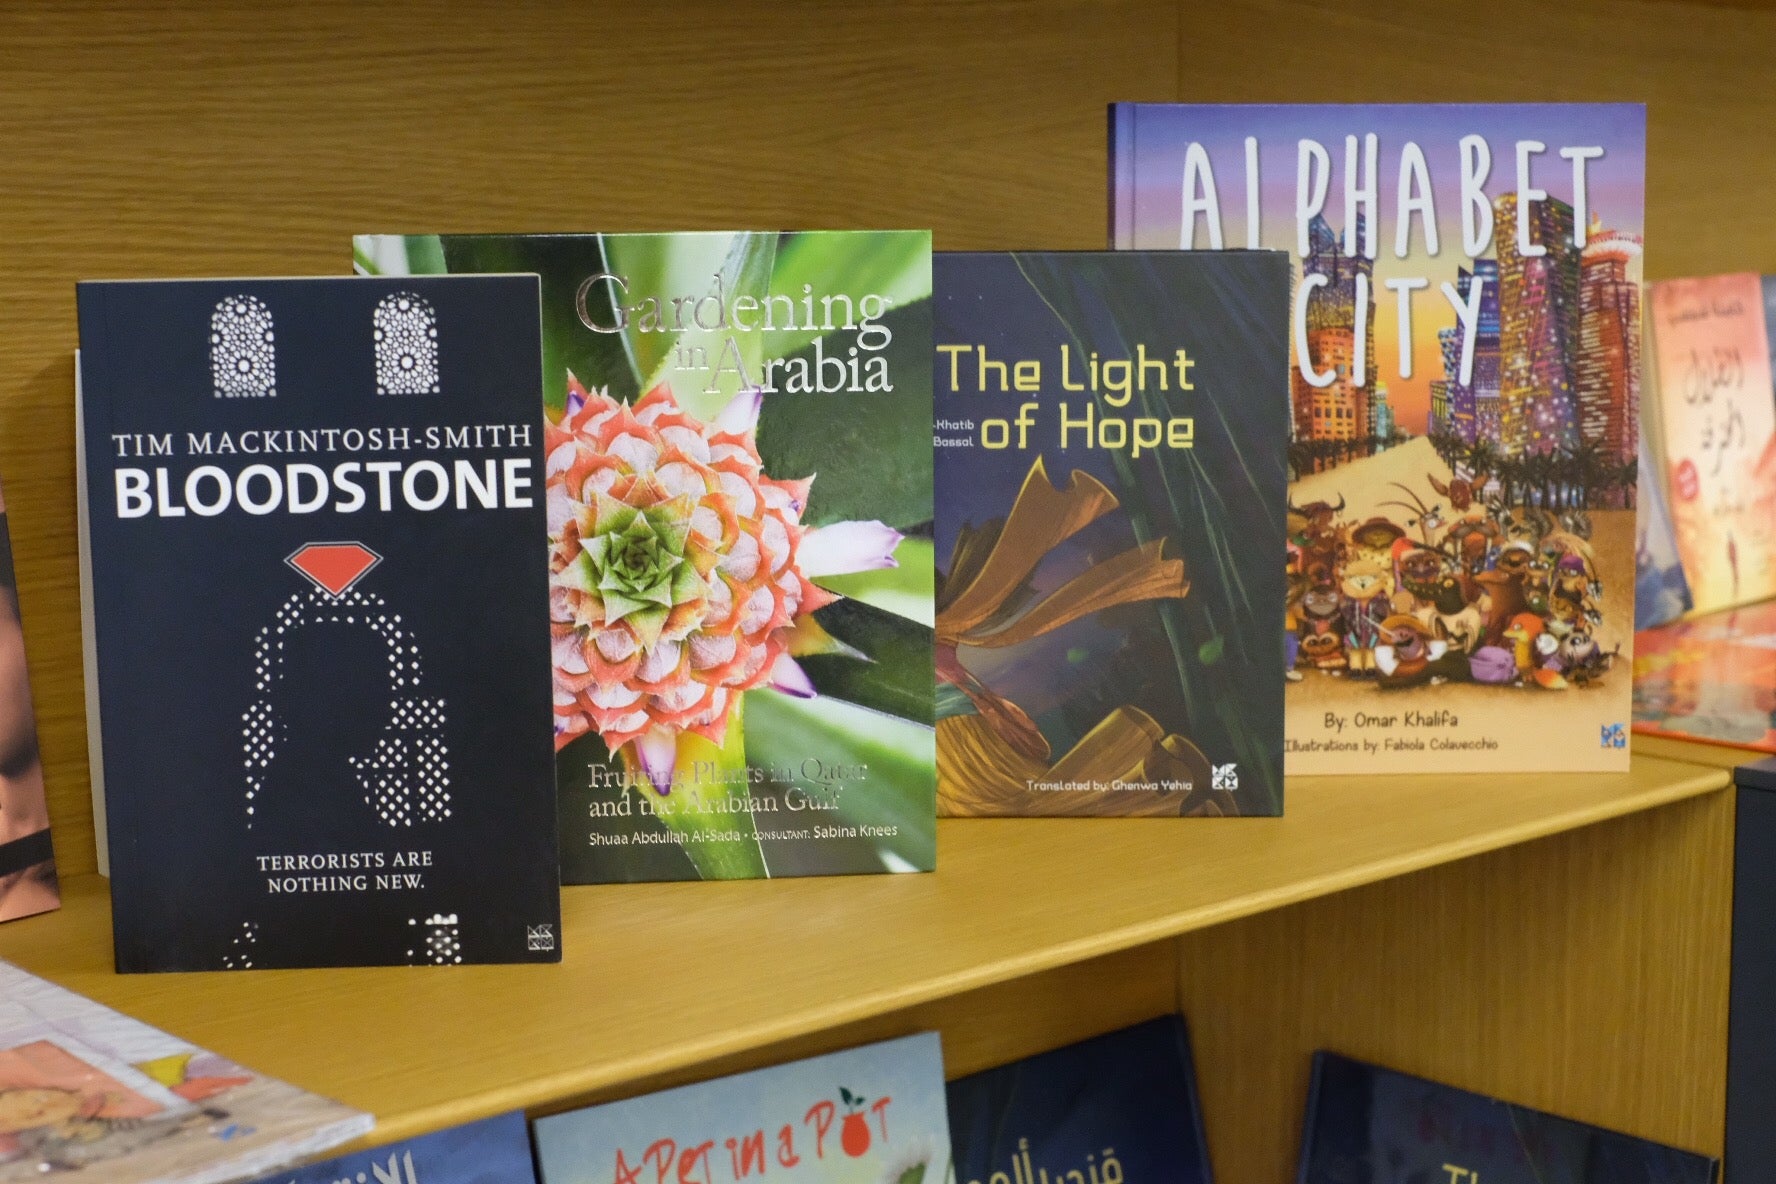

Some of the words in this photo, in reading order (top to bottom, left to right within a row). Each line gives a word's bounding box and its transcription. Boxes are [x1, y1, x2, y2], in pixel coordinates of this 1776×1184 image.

[1179, 132, 1604, 259] ALPHABET
[575, 270, 893, 351] Gardening
[1294, 271, 1484, 388] CITY
[674, 341, 710, 371] in
[702, 335, 894, 394] Arabia
[936, 344, 1041, 392] The
[1060, 343, 1195, 408] Light
[112, 432, 173, 457] TIM
[187, 423, 532, 455] MACKINTOSH-SMITH
[933, 435, 975, 447] Bassal
[980, 402, 1039, 450] of
[1059, 402, 1195, 459] Hope
[114, 457, 534, 519] BLOODSTONE
[1354, 711, 1398, 728] Omar
[1404, 709, 1459, 728] Khalifa
[1284, 738, 1359, 753] Illustrations
[1384, 738, 1425, 750] Fabiola
[1429, 737, 1499, 750] Colavecchio
[588, 792, 633, 818] and
[638, 793, 677, 816] the
[682, 789, 779, 815] Arabian
[783, 786, 843, 812] Gulf
[1026, 779, 1091, 792] Translated
[1111, 779, 1159, 792] Ghenwa
[1161, 779, 1193, 792] Yehia
[588, 831, 629, 847] Shuaa
[631, 830, 689, 846] Abdullah
[691, 828, 741, 843] Al-Sada
[751, 829, 812, 842] CONSULTANT:
[813, 824, 857, 839] Sabina
[859, 823, 899, 838] Knees
[256, 852, 386, 872] TERRORISTS
[392, 850, 433, 867] ARE
[267, 874, 368, 894] NOTHING
[375, 872, 426, 890] NEW.
